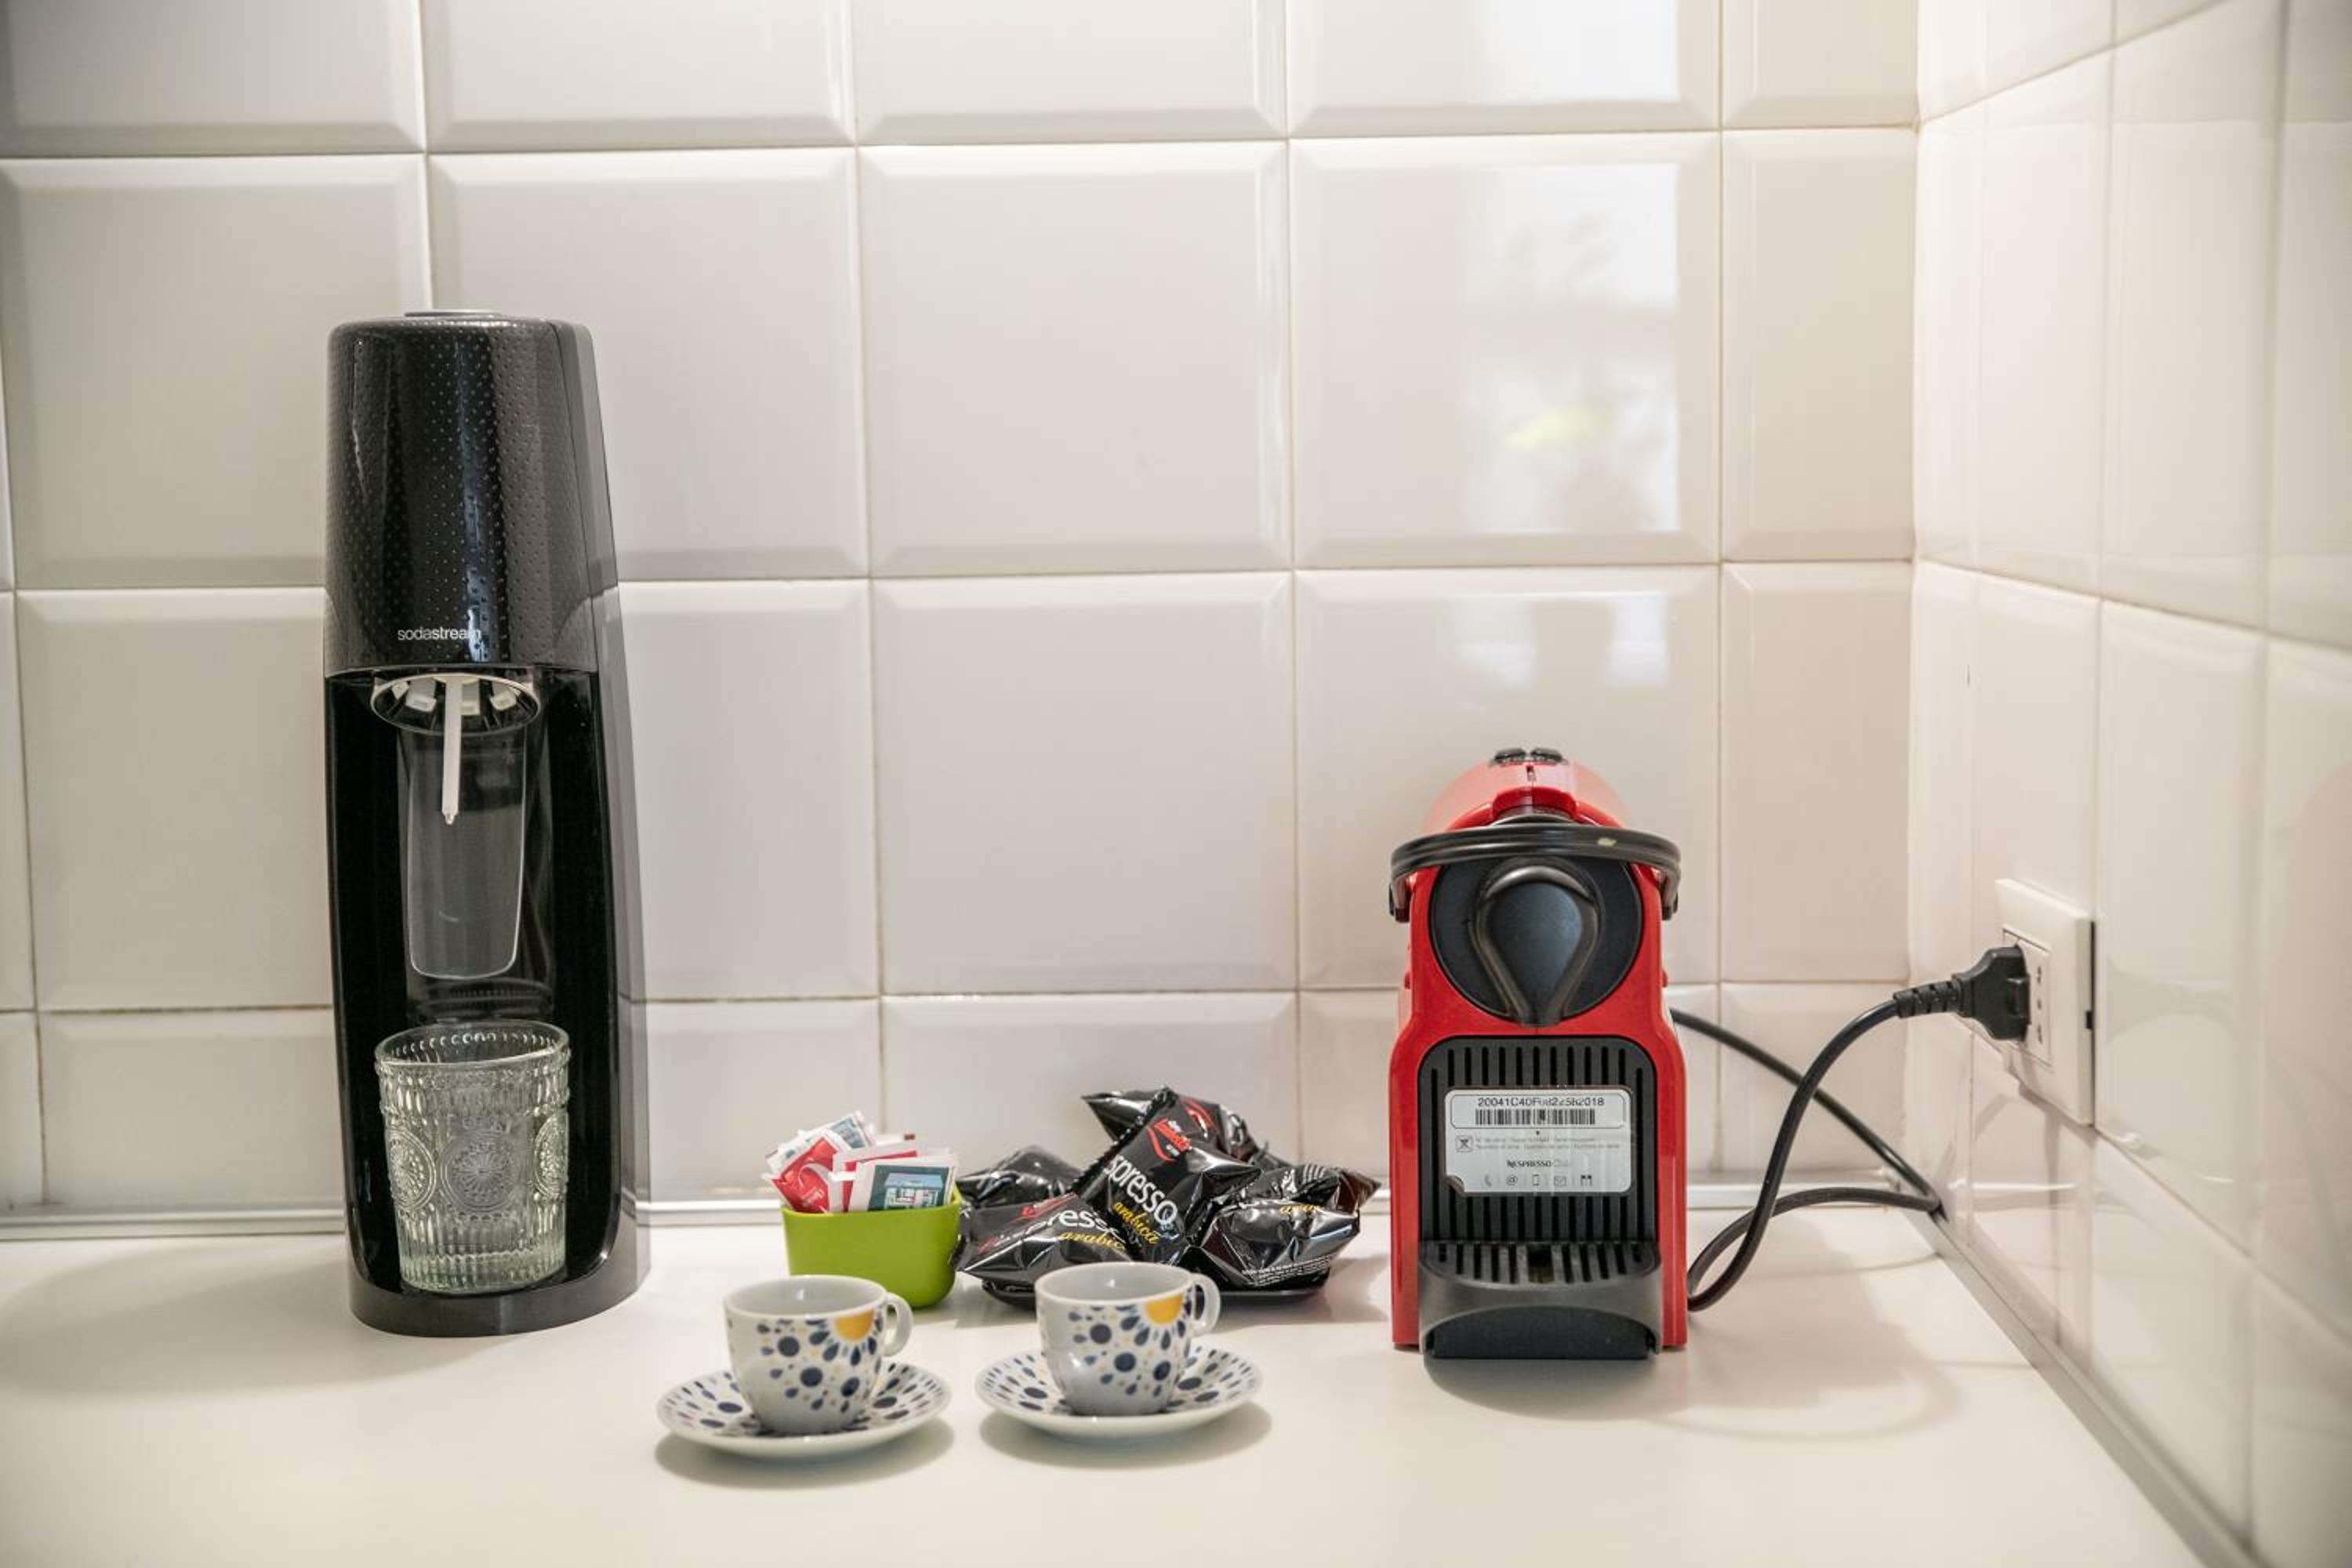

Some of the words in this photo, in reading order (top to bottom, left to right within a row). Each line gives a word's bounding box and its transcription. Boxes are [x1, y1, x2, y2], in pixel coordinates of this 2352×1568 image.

[397, 626, 481, 641] sodastream
[1102, 1155, 1178, 1224] spresso
[1114, 1202, 1159, 1244] arabica
